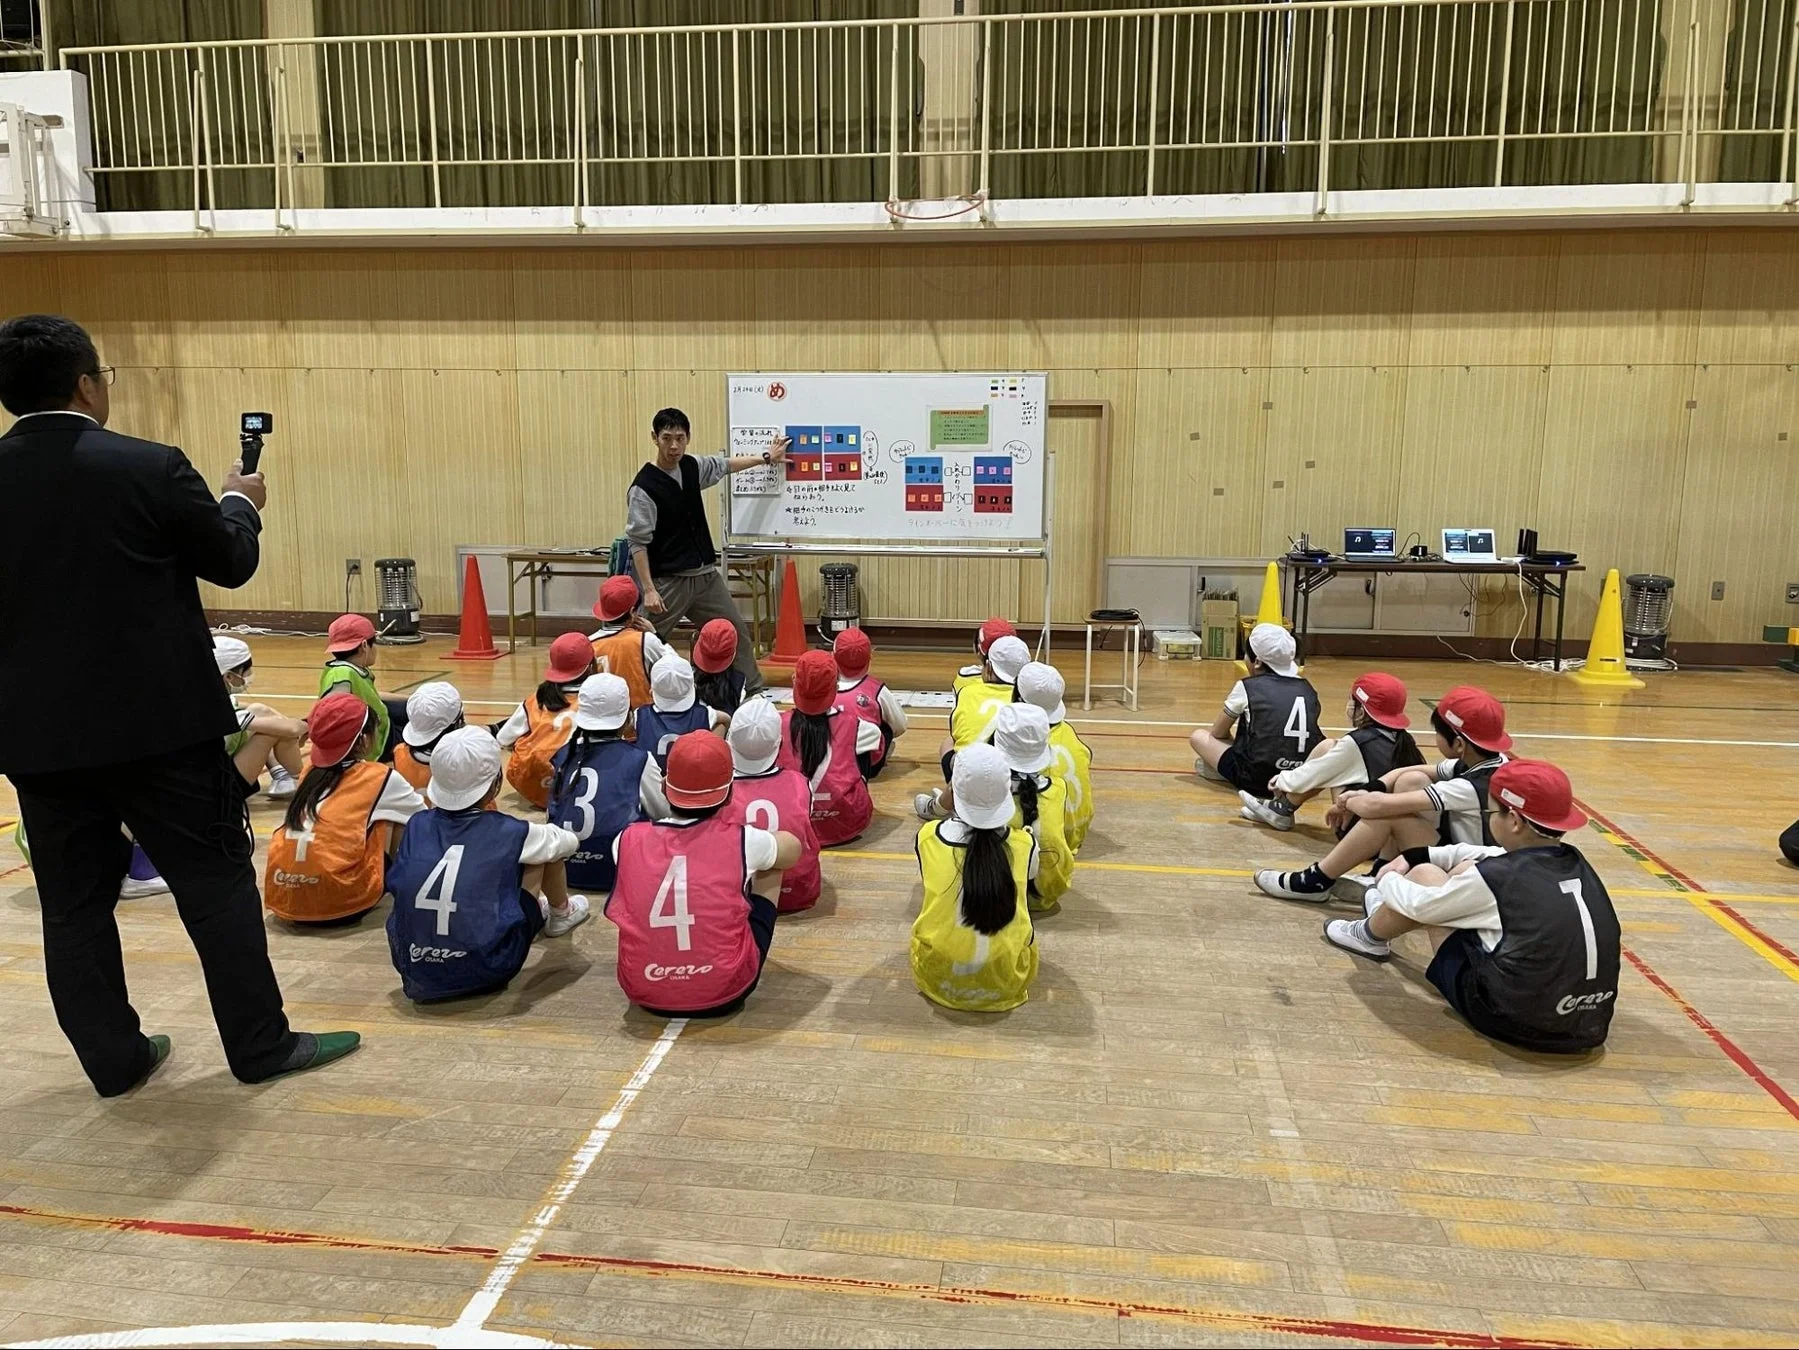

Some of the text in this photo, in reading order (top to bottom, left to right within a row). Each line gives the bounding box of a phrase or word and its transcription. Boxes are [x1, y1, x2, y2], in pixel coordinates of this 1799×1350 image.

[769, 383, 785, 399] め
[1283, 696, 1310, 753] 4
[563, 767, 599, 841] 3
[415, 844, 465, 936] 4
[649, 855, 695, 951] 4
[409, 943, 467, 962] Cerezo
[644, 963, 713, 982] Cerezo
[1556, 991, 1614, 1015] Cerezo
